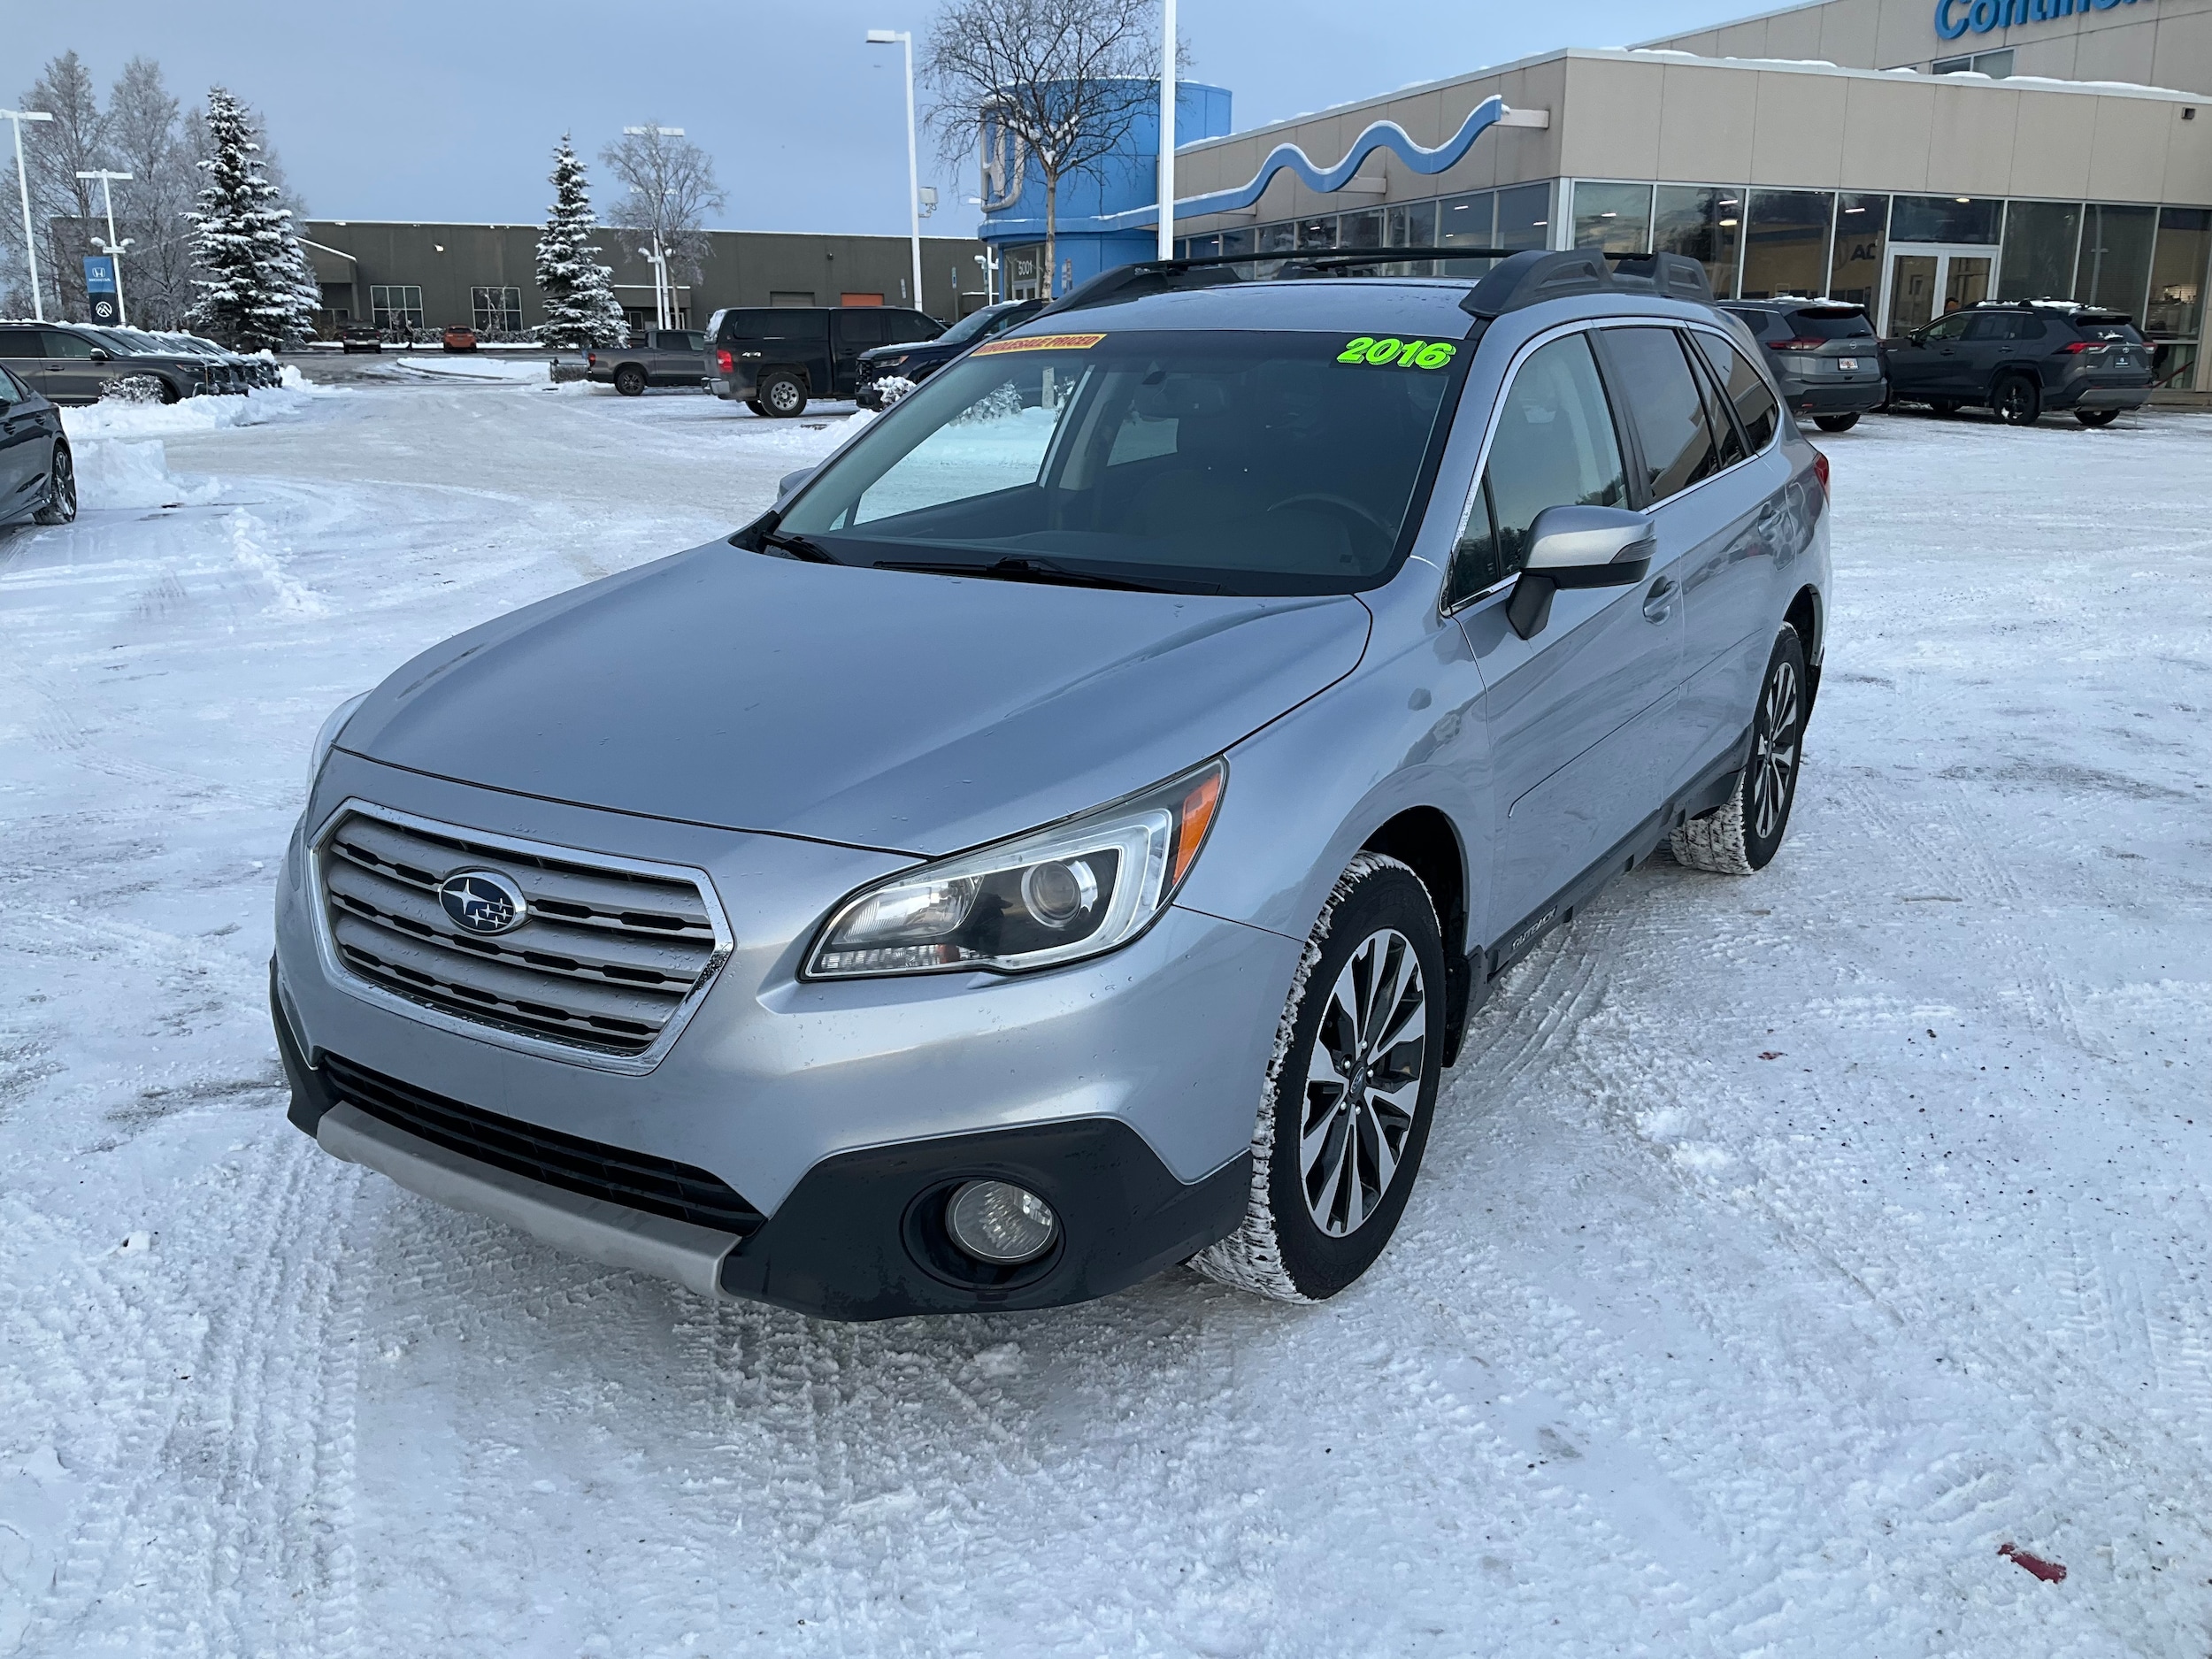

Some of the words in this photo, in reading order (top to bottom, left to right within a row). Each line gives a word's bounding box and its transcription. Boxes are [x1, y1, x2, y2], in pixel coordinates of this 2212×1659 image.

[1018, 259, 1033, 276] 5001
[1336, 336, 1456, 370] 2016
[1512, 907, 1556, 949] OUTBACK
